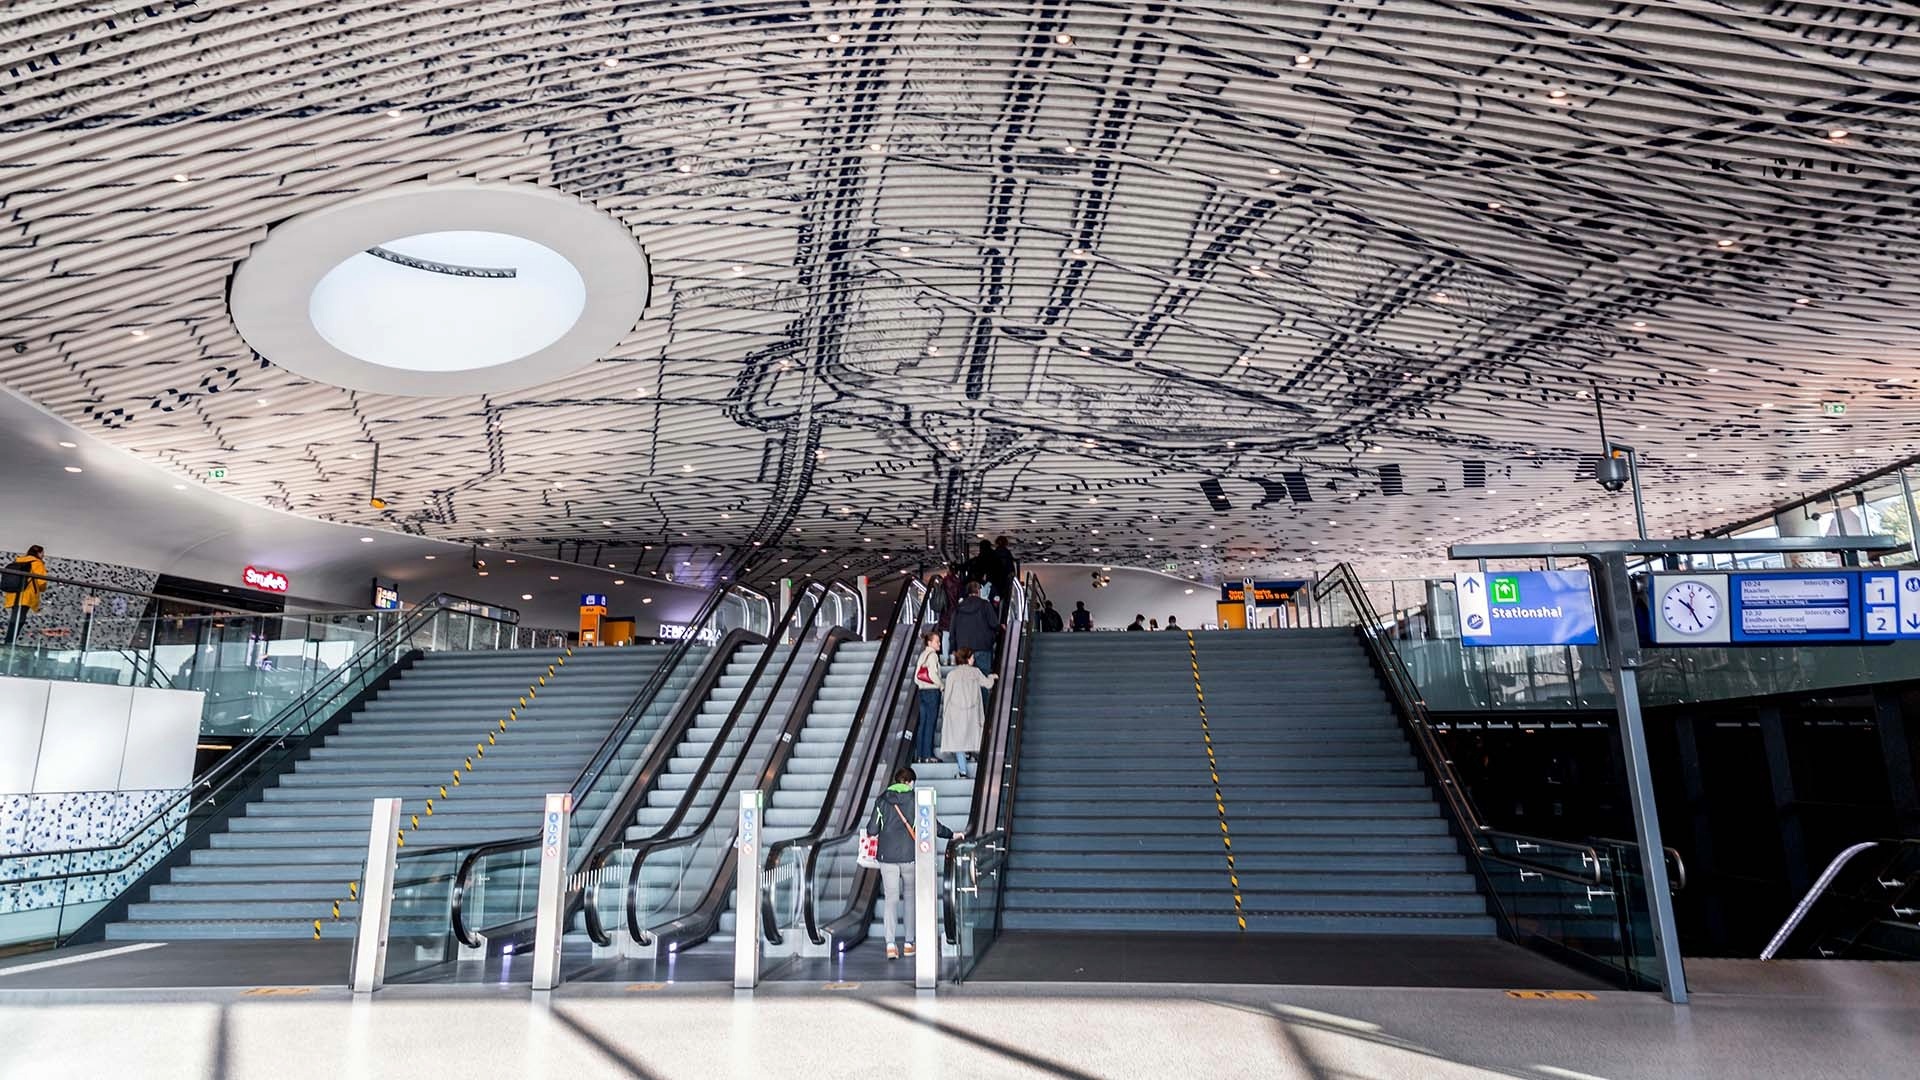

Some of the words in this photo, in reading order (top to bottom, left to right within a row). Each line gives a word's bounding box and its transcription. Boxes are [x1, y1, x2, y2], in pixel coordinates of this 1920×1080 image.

[1877, 588, 1885, 601] 1
[1492, 606, 1562, 619] Stationshal
[1876, 617, 1887, 631] 2
